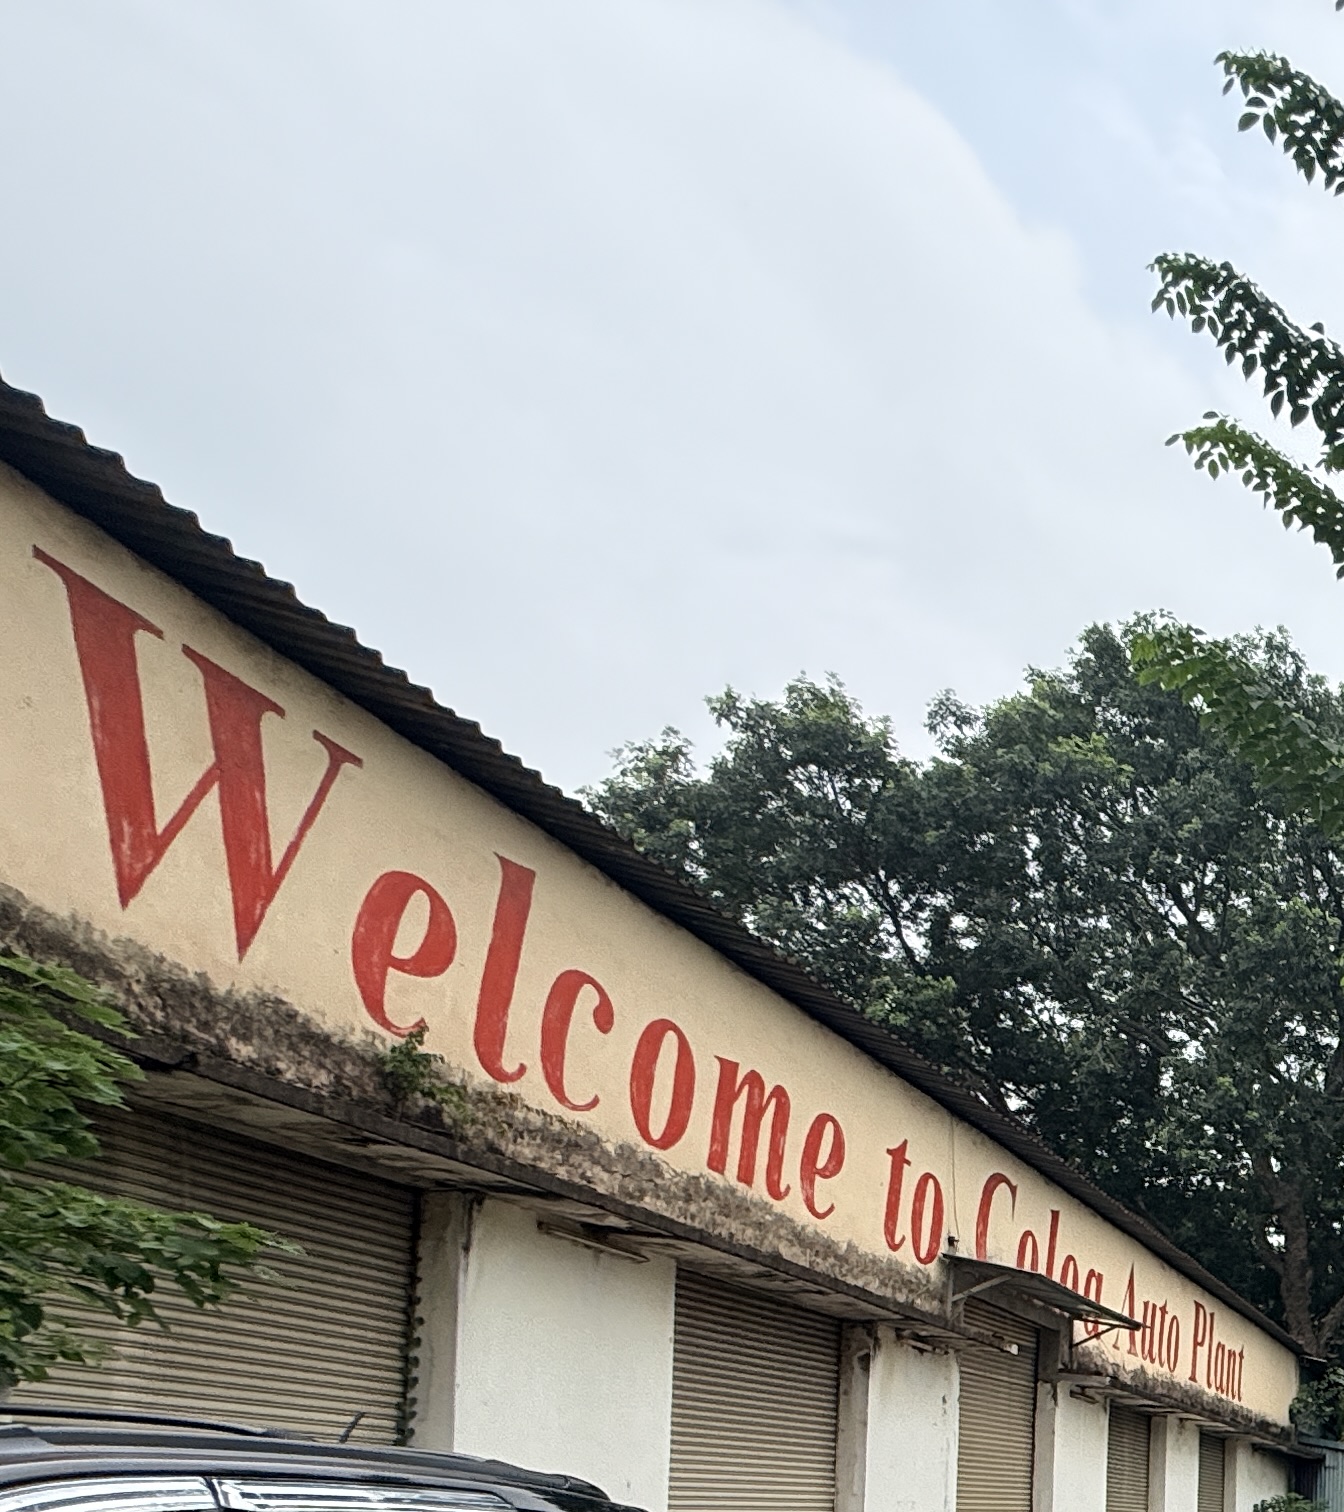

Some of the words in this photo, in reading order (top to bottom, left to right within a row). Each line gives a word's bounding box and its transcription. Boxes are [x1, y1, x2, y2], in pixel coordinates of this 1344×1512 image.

[32, 543, 845, 1220] Welcome
[884, 1139, 945, 1265] to
[1112, 1261, 1180, 1373] Auto
[1188, 1300, 1246, 1402] Plant
